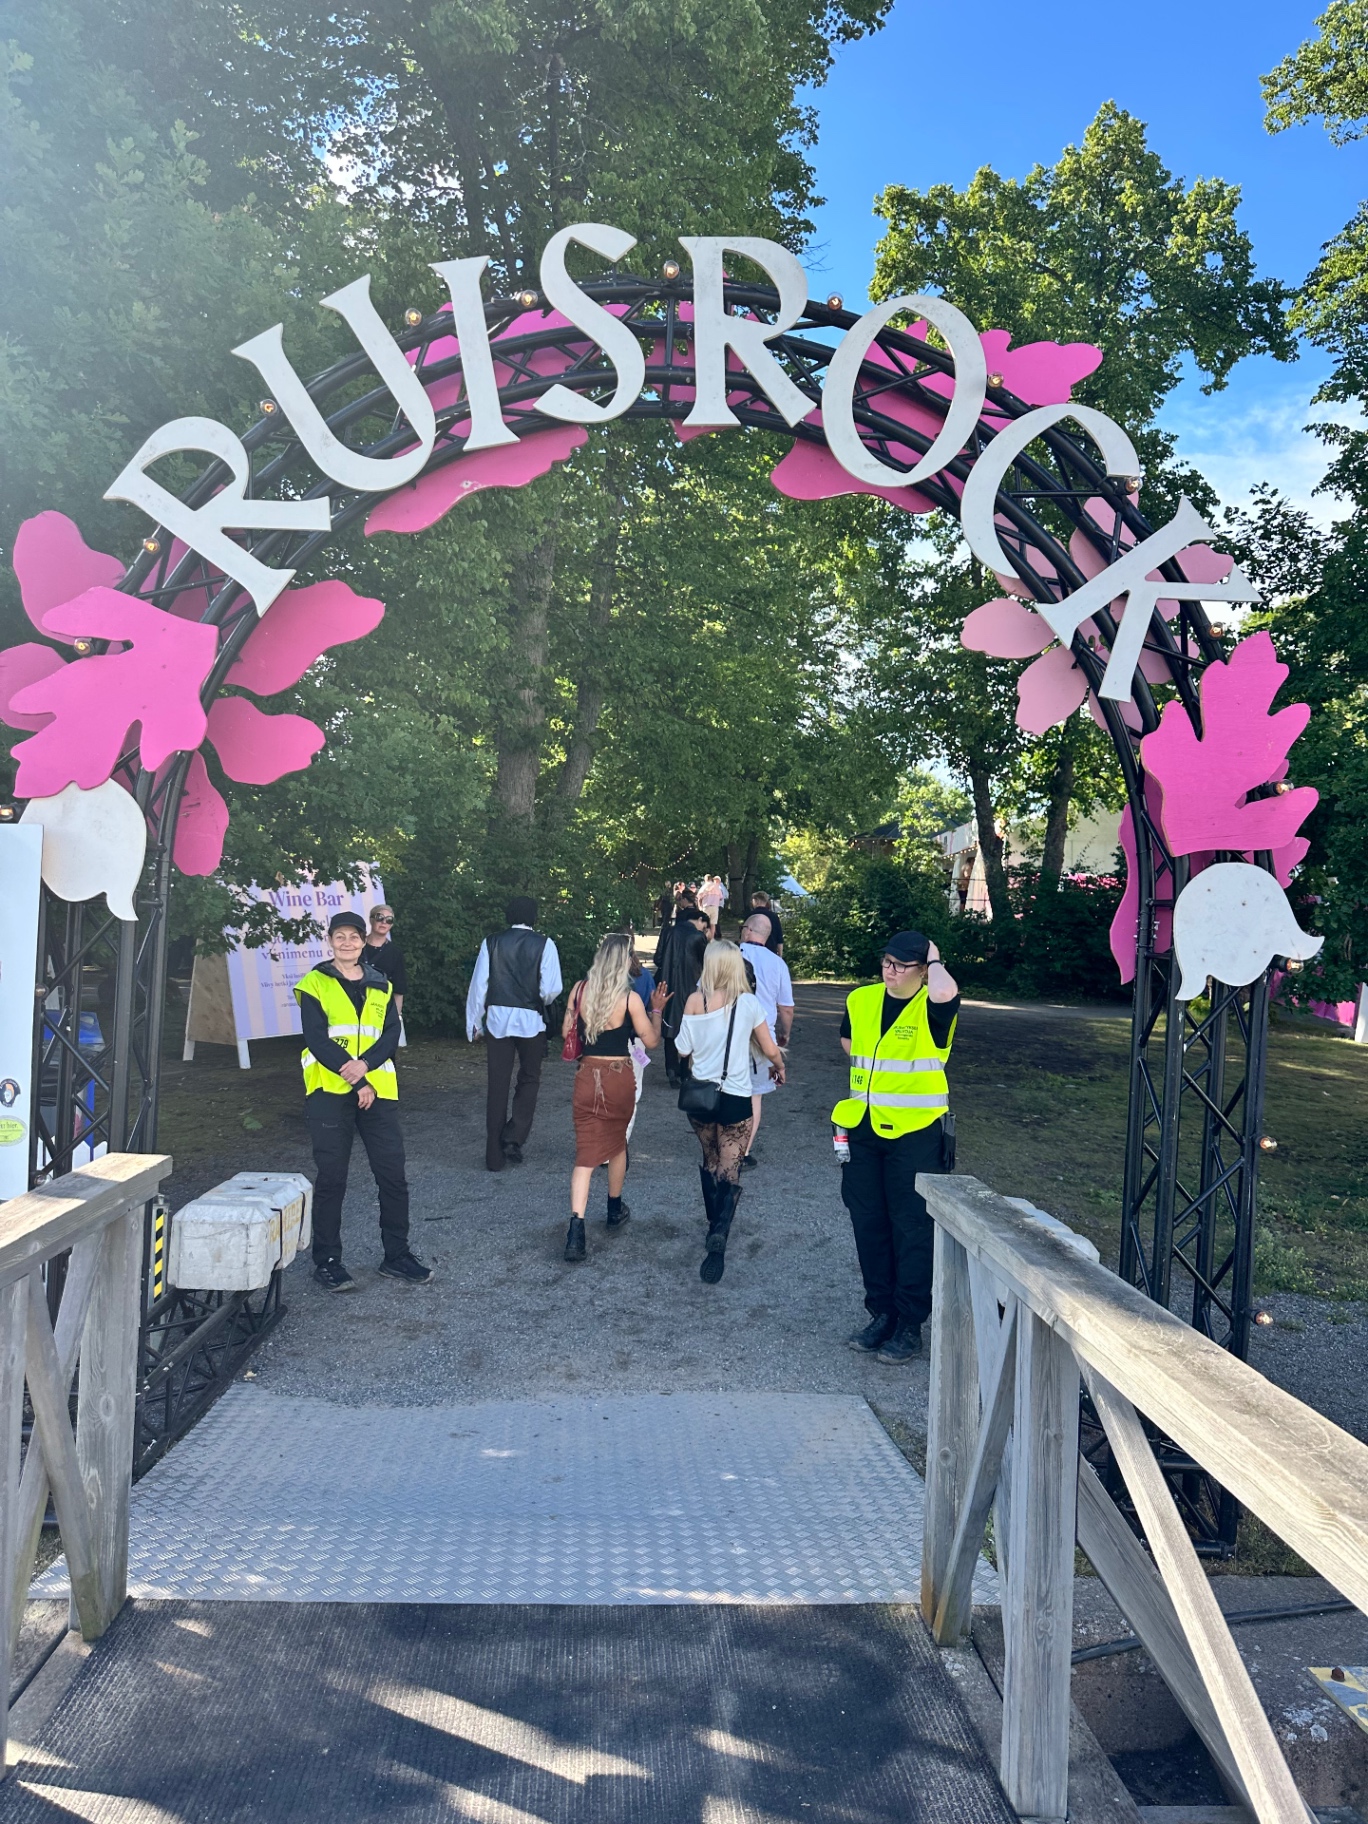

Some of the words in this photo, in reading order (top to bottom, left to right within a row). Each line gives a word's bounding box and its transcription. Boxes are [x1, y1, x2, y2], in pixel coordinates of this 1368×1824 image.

[103, 222, 1261, 703] RUISROCK
[268, 891, 312, 907] Wine
[315, 891, 344, 907] Bar
